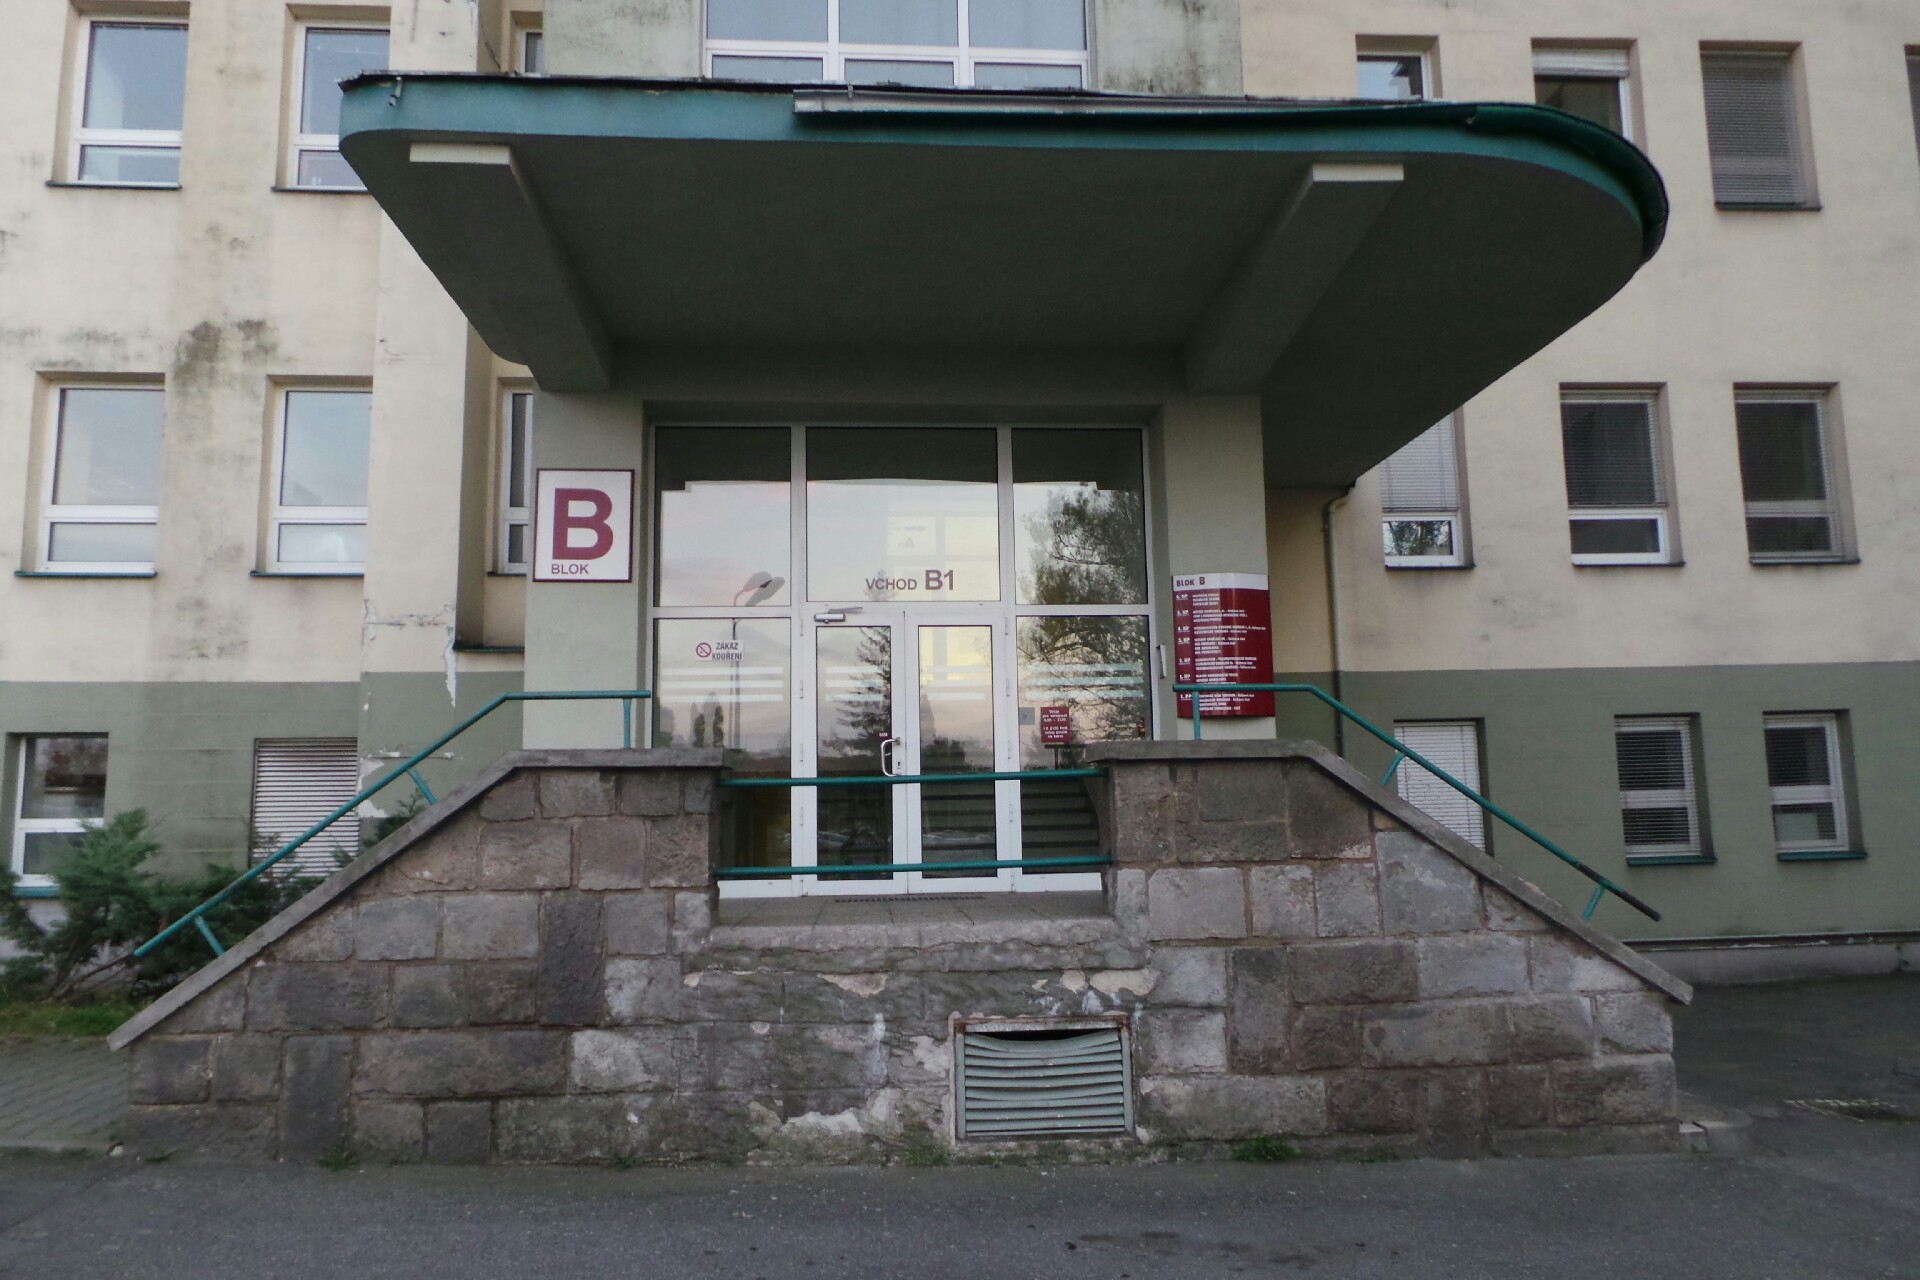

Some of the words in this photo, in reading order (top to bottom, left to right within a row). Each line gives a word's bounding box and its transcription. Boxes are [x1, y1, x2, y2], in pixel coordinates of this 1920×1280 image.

[552, 488, 613, 560] B
[551, 563, 589, 575] BLOK
[865, 578, 917, 590] VCHOD
[925, 569, 954, 590] B1
[1176, 579, 1195, 587] BLOK
[1199, 576, 1206, 585] B
[716, 641, 739, 650] ZÁKAZ
